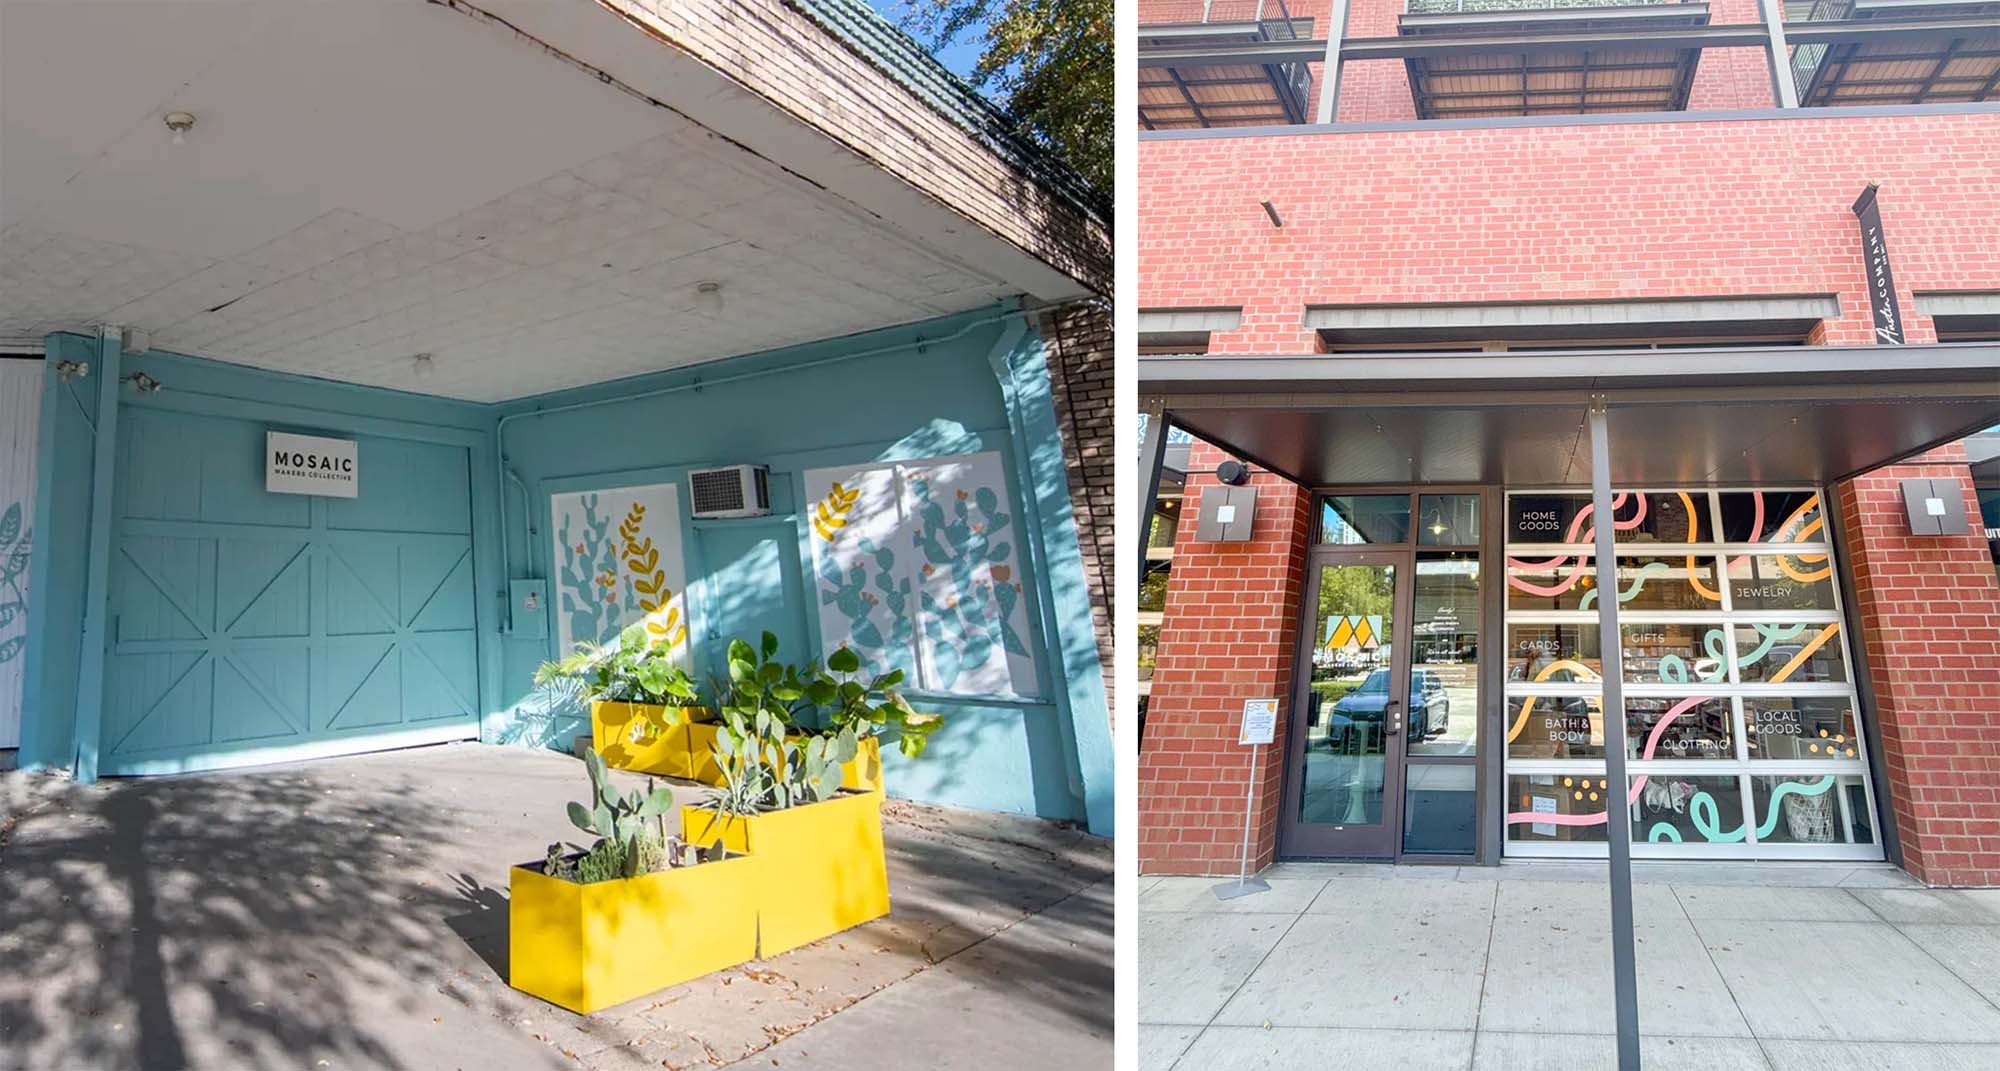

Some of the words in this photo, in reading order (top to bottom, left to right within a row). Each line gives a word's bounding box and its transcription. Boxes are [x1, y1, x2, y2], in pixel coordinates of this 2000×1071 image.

[1868, 226, 1887, 298] COMPANY
[274, 451, 352, 472] MOSAIC
[274, 469, 306, 477] MAKERS
[308, 471, 352, 481] COLLECTIVE
[1522, 511, 1556, 520] HOME
[1519, 521, 1560, 530] GOODS
[1737, 587, 1793, 598] JEWELRY
[1631, 633, 1665, 643] GIFTS
[1519, 640, 1560, 650] CARDS
[1756, 711, 1798, 722] LOCAL
[1545, 718, 1577, 729] BATH
[1581, 718, 1589, 729] &
[1756, 723, 1802, 734] GOODS
[1550, 731, 1585, 742] BODY
[1662, 739, 1728, 750] CLOTHING
